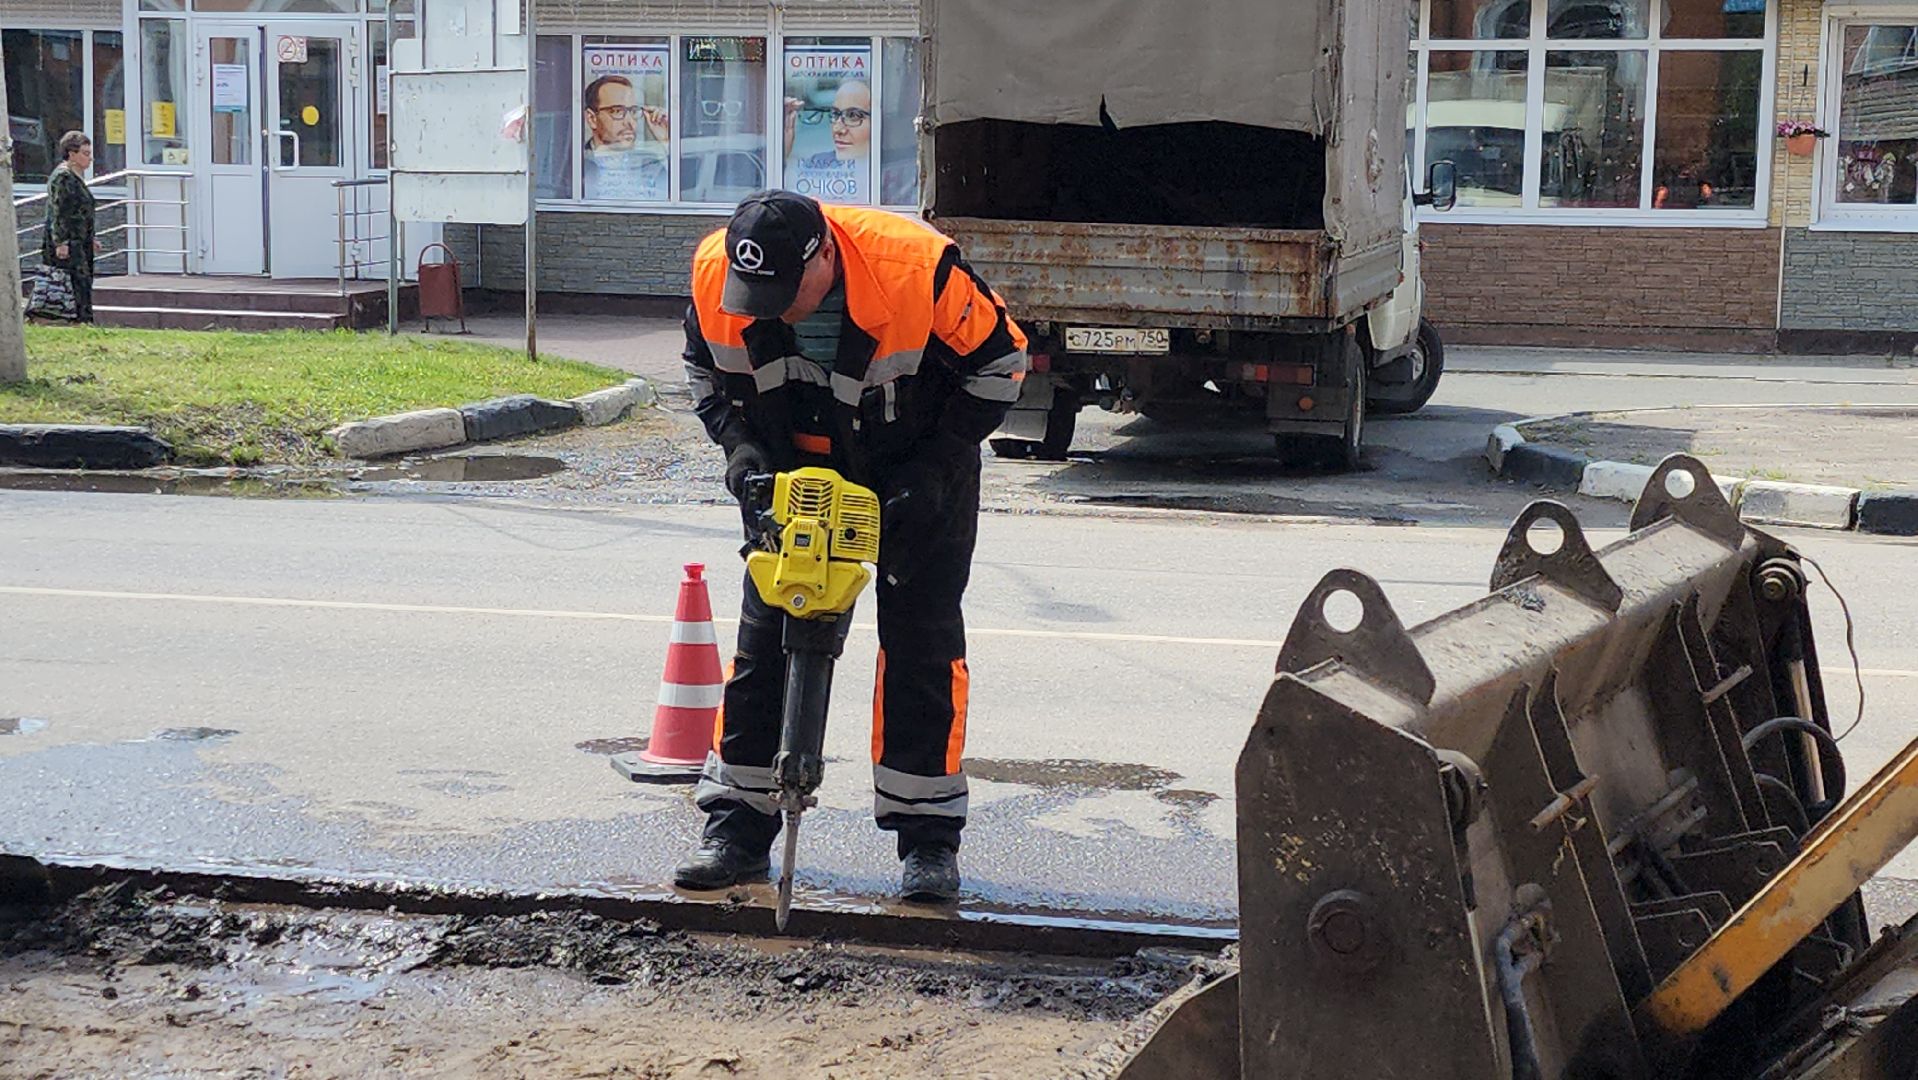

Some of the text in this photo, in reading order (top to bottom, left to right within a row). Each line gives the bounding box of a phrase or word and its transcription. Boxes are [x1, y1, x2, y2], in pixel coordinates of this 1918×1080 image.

[591, 54, 663, 67] ОПТИКА
[791, 56, 865, 68] ОПТИКА
[797, 179, 857, 195] ОЧКОВ
